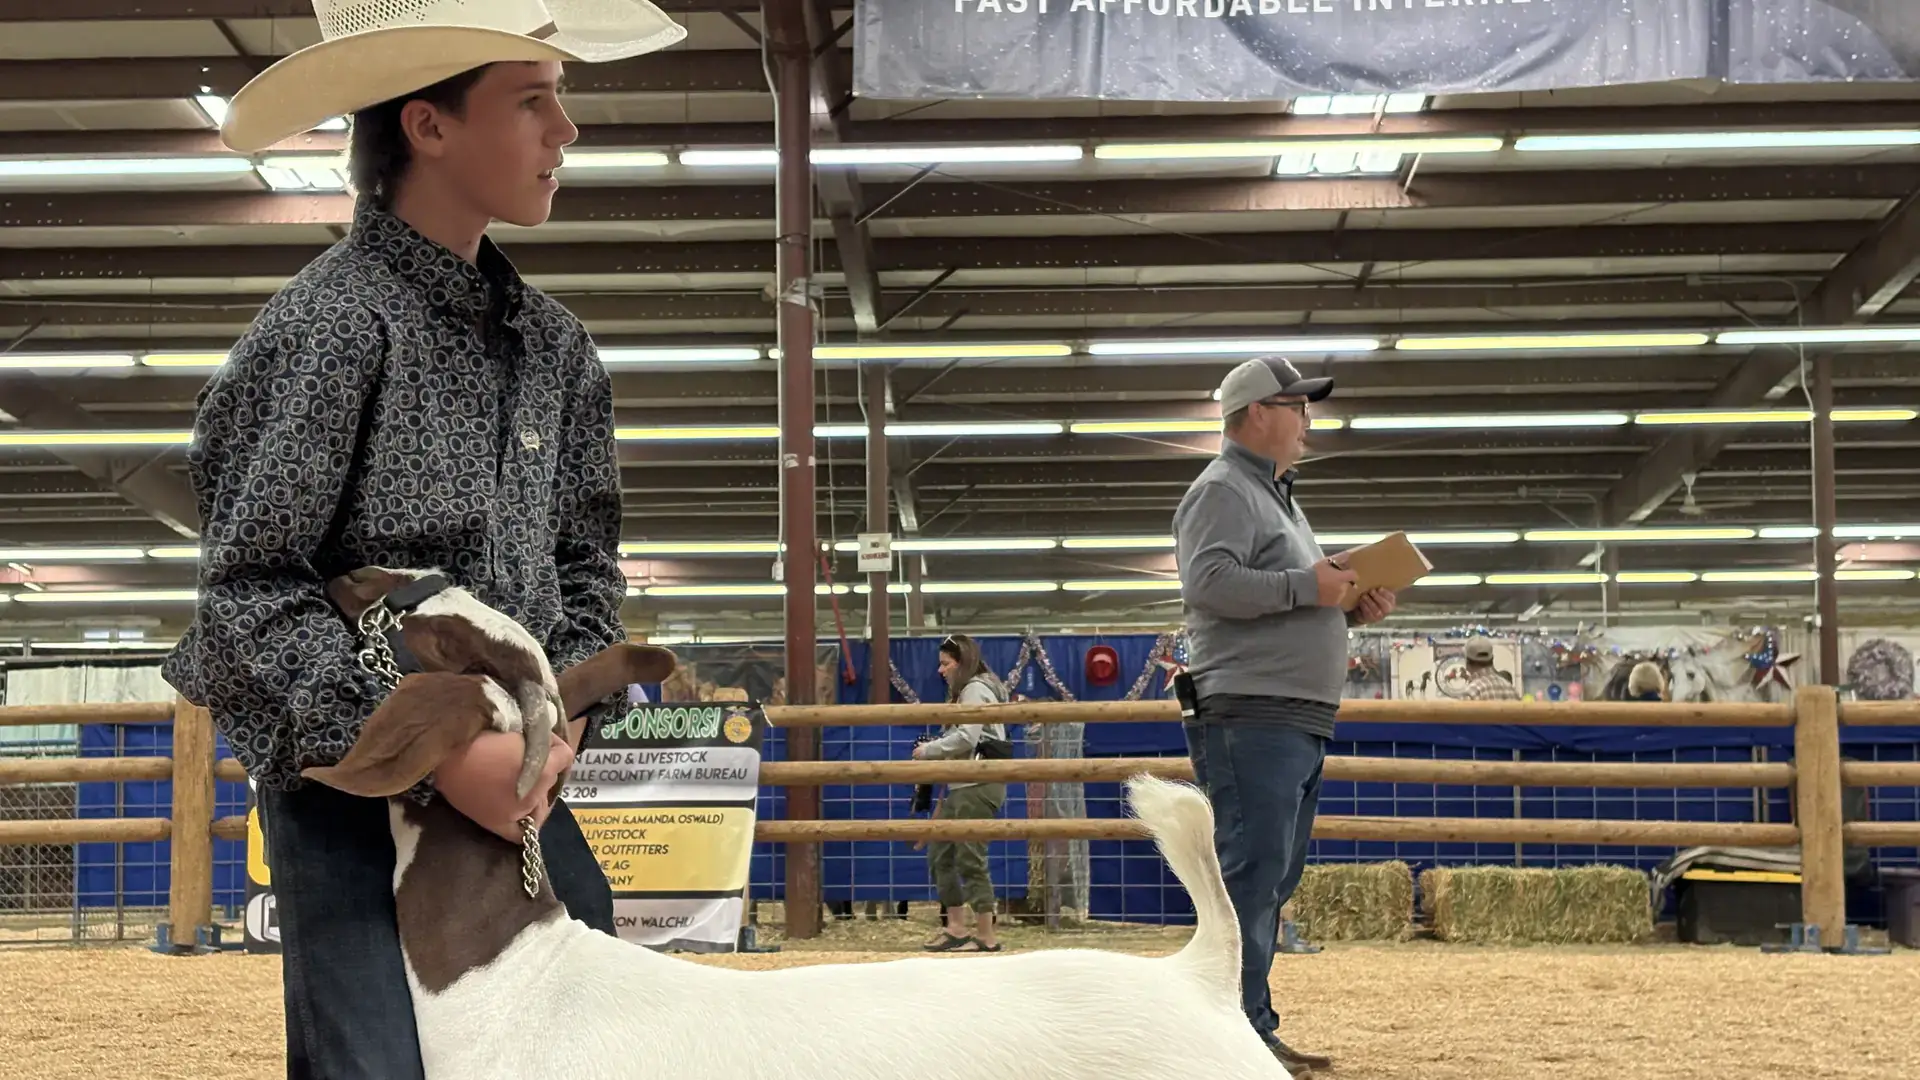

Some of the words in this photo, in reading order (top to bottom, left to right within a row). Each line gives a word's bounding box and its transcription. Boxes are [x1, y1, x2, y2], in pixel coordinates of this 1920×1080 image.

[585, 752, 621, 765] LAND
[624, 752, 634, 765] &
[638, 751, 708, 765] LIVESTOCK
[599, 768, 655, 782] COUNTY
[657, 768, 692, 780] FARM
[695, 767, 748, 780] BUREAU
[573, 786, 598, 798] 208
[678, 812, 724, 825] OSWALD)
[586, 829, 647, 840] LIVESTOCK
[602, 844, 669, 855] OUTFITTERS
[612, 859, 630, 870] AG
